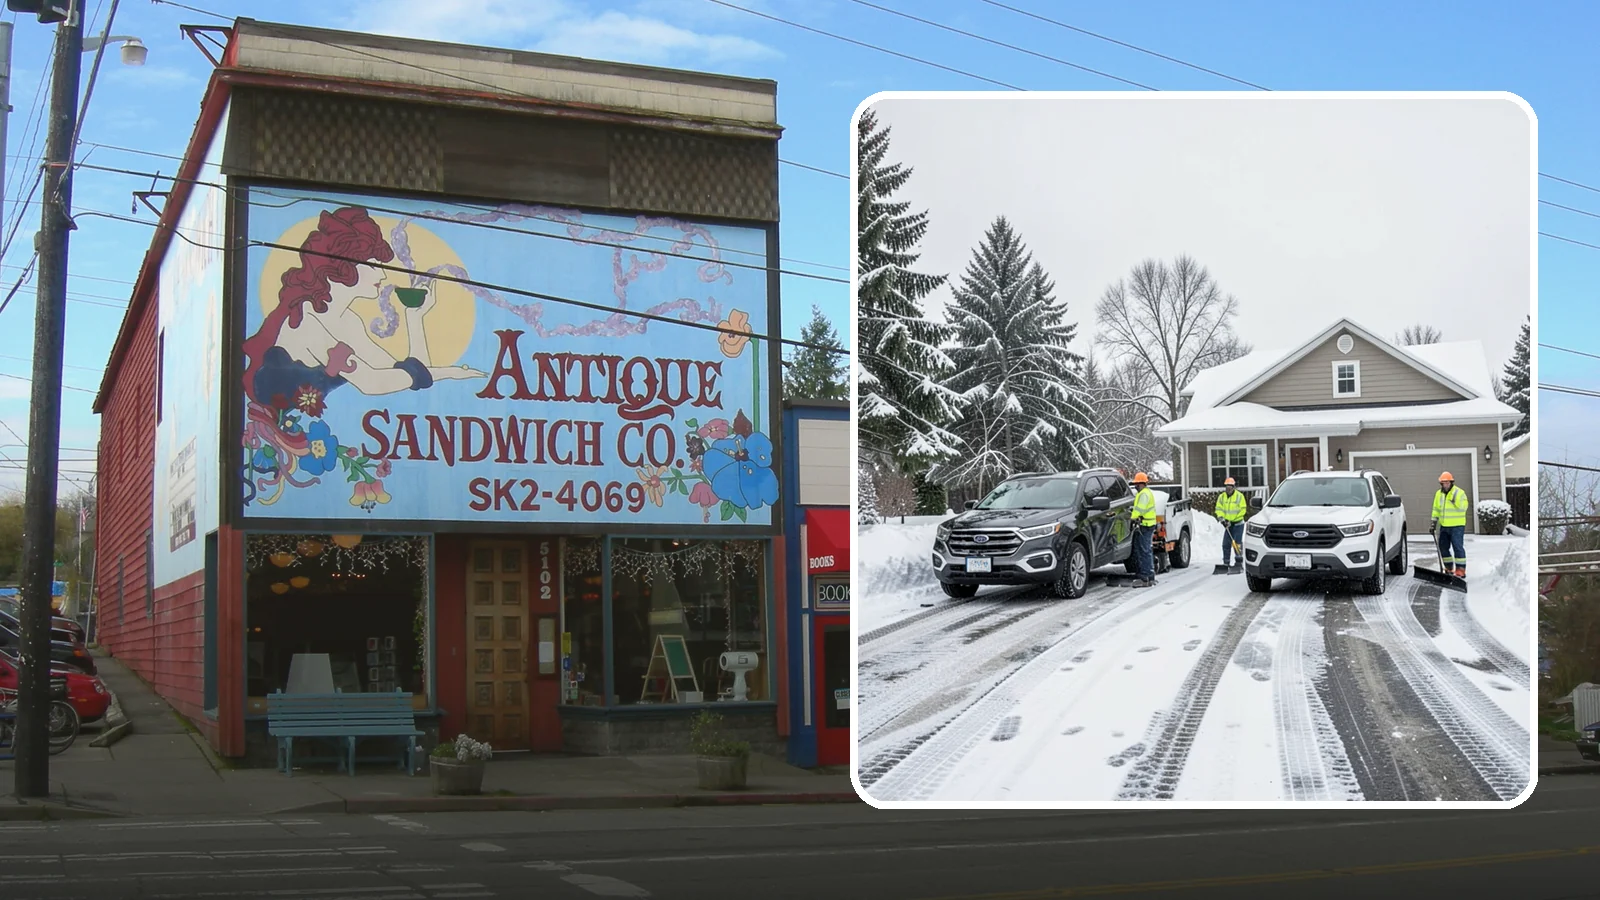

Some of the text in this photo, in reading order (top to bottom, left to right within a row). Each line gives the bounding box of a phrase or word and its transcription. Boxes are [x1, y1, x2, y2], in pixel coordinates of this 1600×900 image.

[476, 329, 723, 421] ANTIQUE
[361, 408, 685, 468] SANDWICH CO.
[468, 477, 645, 513] SK2-4069
[540, 541, 551, 600] 5102
[809, 555, 834, 569] BOOKS
